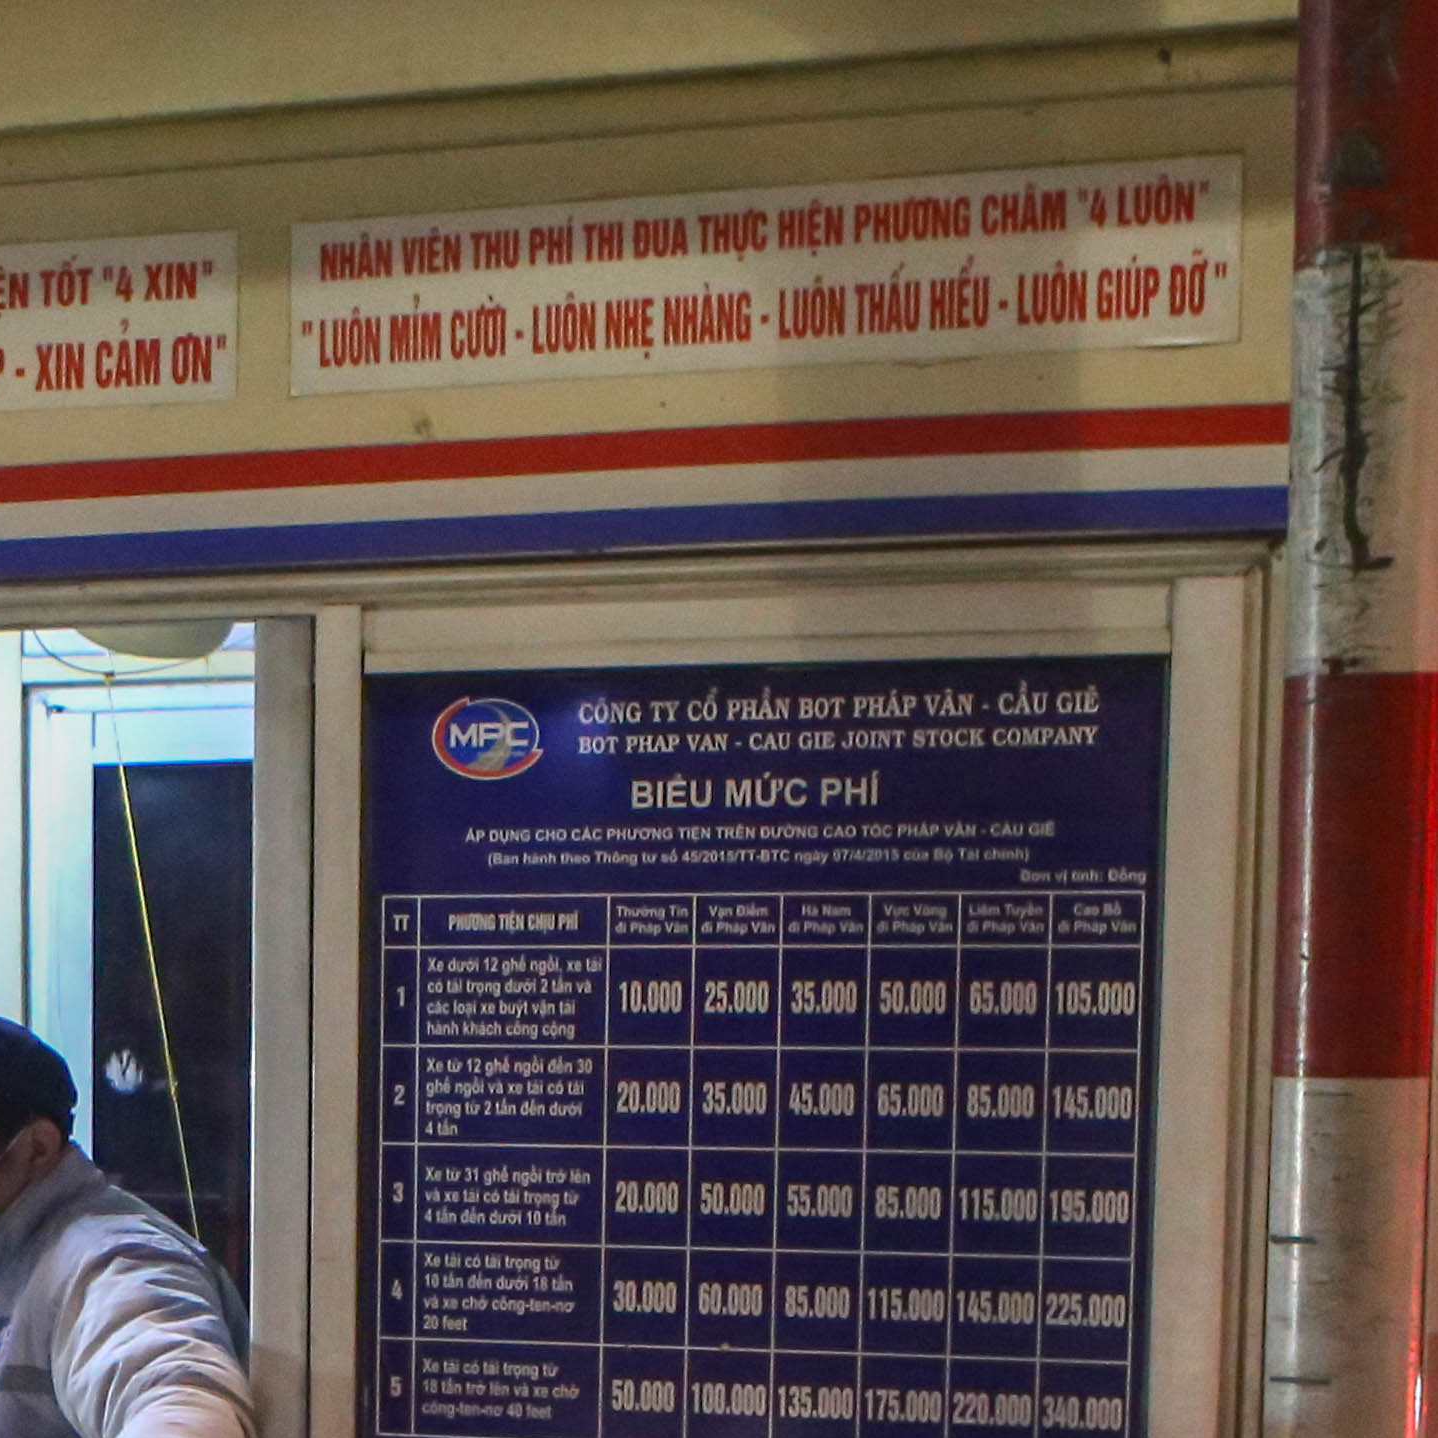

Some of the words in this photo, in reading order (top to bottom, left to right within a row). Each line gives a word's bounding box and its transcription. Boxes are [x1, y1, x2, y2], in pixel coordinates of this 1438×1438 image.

[320, 232, 393, 282] NHÂN
[402, 227, 461, 275] VIÊN
[471, 229, 520, 270] THU
[529, 216, 573, 267] PHÍ
[583, 221, 623, 262] THI
[632, 218, 688, 259] ĐUA
[698, 208, 767, 262] THỰC
[778, 199, 844, 257] HIỆN
[854, 196, 970, 244] PHƯƠNG
[981, 183, 1066, 236] CHÂM
[39, 254, 93, 307] TỐT
[390, 293, 441, 363] MỈM
[450, 294, 506, 359] CƯỜI
[532, 291, 595, 354] LUÔN
[605, 298, 654, 359] NHẸ
[663, 282, 751, 345] NHÀNG
[779, 274, 845, 340] LUÔN
[855, 262, 921, 334] THẤU
[1018, 260, 1087, 325] LUÔN
[1096, 254, 1160, 320] GIÚP
[36, 342, 85, 392] XIN
[96, 319, 161, 388] CẢM
[578, 697, 642, 725] CÔNG
[651, 701, 678, 723] TY
[687, 687, 718, 721] CỔ
[727, 687, 790, 721] PHẦN
[799, 696, 845, 719] BOT
[853, 689, 916, 719] PHÁP
[924, 688, 975, 716] VÂN
[998, 681, 1048, 715] CẦU
[449, 721, 529, 749] MPC
[578, 735, 618, 754] BOT
[625, 734, 680, 753] PHAP
[687, 733, 729, 752] VAN
[748, 731, 790, 751] CAU
[799, 730, 836, 750] GIE
[841, 729, 906, 749] JOINT
[912, 727, 985, 747] STOCK
[992, 725, 1100, 746] COMPANY
[725, 771, 808, 808] MỨC
[820, 770, 880, 806] PHÍ
[535, 828, 567, 842] CHO
[824, 823, 856, 839] CAO
[392, 914, 410, 932] TT
[396, 985, 406, 1008] 1
[619, 981, 682, 1013] 10.000
[704, 981, 770, 1014] 25.000
[791, 981, 857, 1014] 35.000
[879, 981, 947, 1014] 50.000
[969, 981, 1038, 1015] 65.000
[1055, 981, 1135, 1016] 105.000
[393, 1084, 406, 1106] 2
[617, 1082, 681, 1114] 20.000
[702, 1082, 767, 1115] 35.000
[789, 1083, 855, 1116] 45.000
[877, 1084, 944, 1117] 65.000
[967, 1085, 1034, 1118] 85.000
[1052, 1086, 1132, 1120] 145.000
[392, 1181, 404, 1203] 3
[615, 1182, 679, 1213] 20.000
[700, 1184, 765, 1216] 50.000
[787, 1185, 853, 1218] 55.000
[874, 1186, 941, 1220] 85.000
[959, 1188, 1038, 1222] 115.000
[1049, 1190, 1129, 1224] 195.000
[391, 1278, 403, 1300] 4
[613, 1280, 677, 1314] 30.000
[698, 1283, 763, 1316] 60.000
[784, 1285, 850, 1319] 85.000
[867, 1288, 945, 1322] 115.000
[956, 1290, 1034, 1324] 145.000
[1045, 1293, 1125, 1327] 225.000
[390, 1375, 402, 1398] 5
[612, 1380, 675, 1412] 50.000
[691, 1382, 767, 1416] 100.000
[777, 1386, 854, 1419] 135.000
[864, 1389, 942, 1423] 175.000
[952, 1392, 1032, 1426] 220.000
[1042, 1396, 1122, 1430] 340.000
